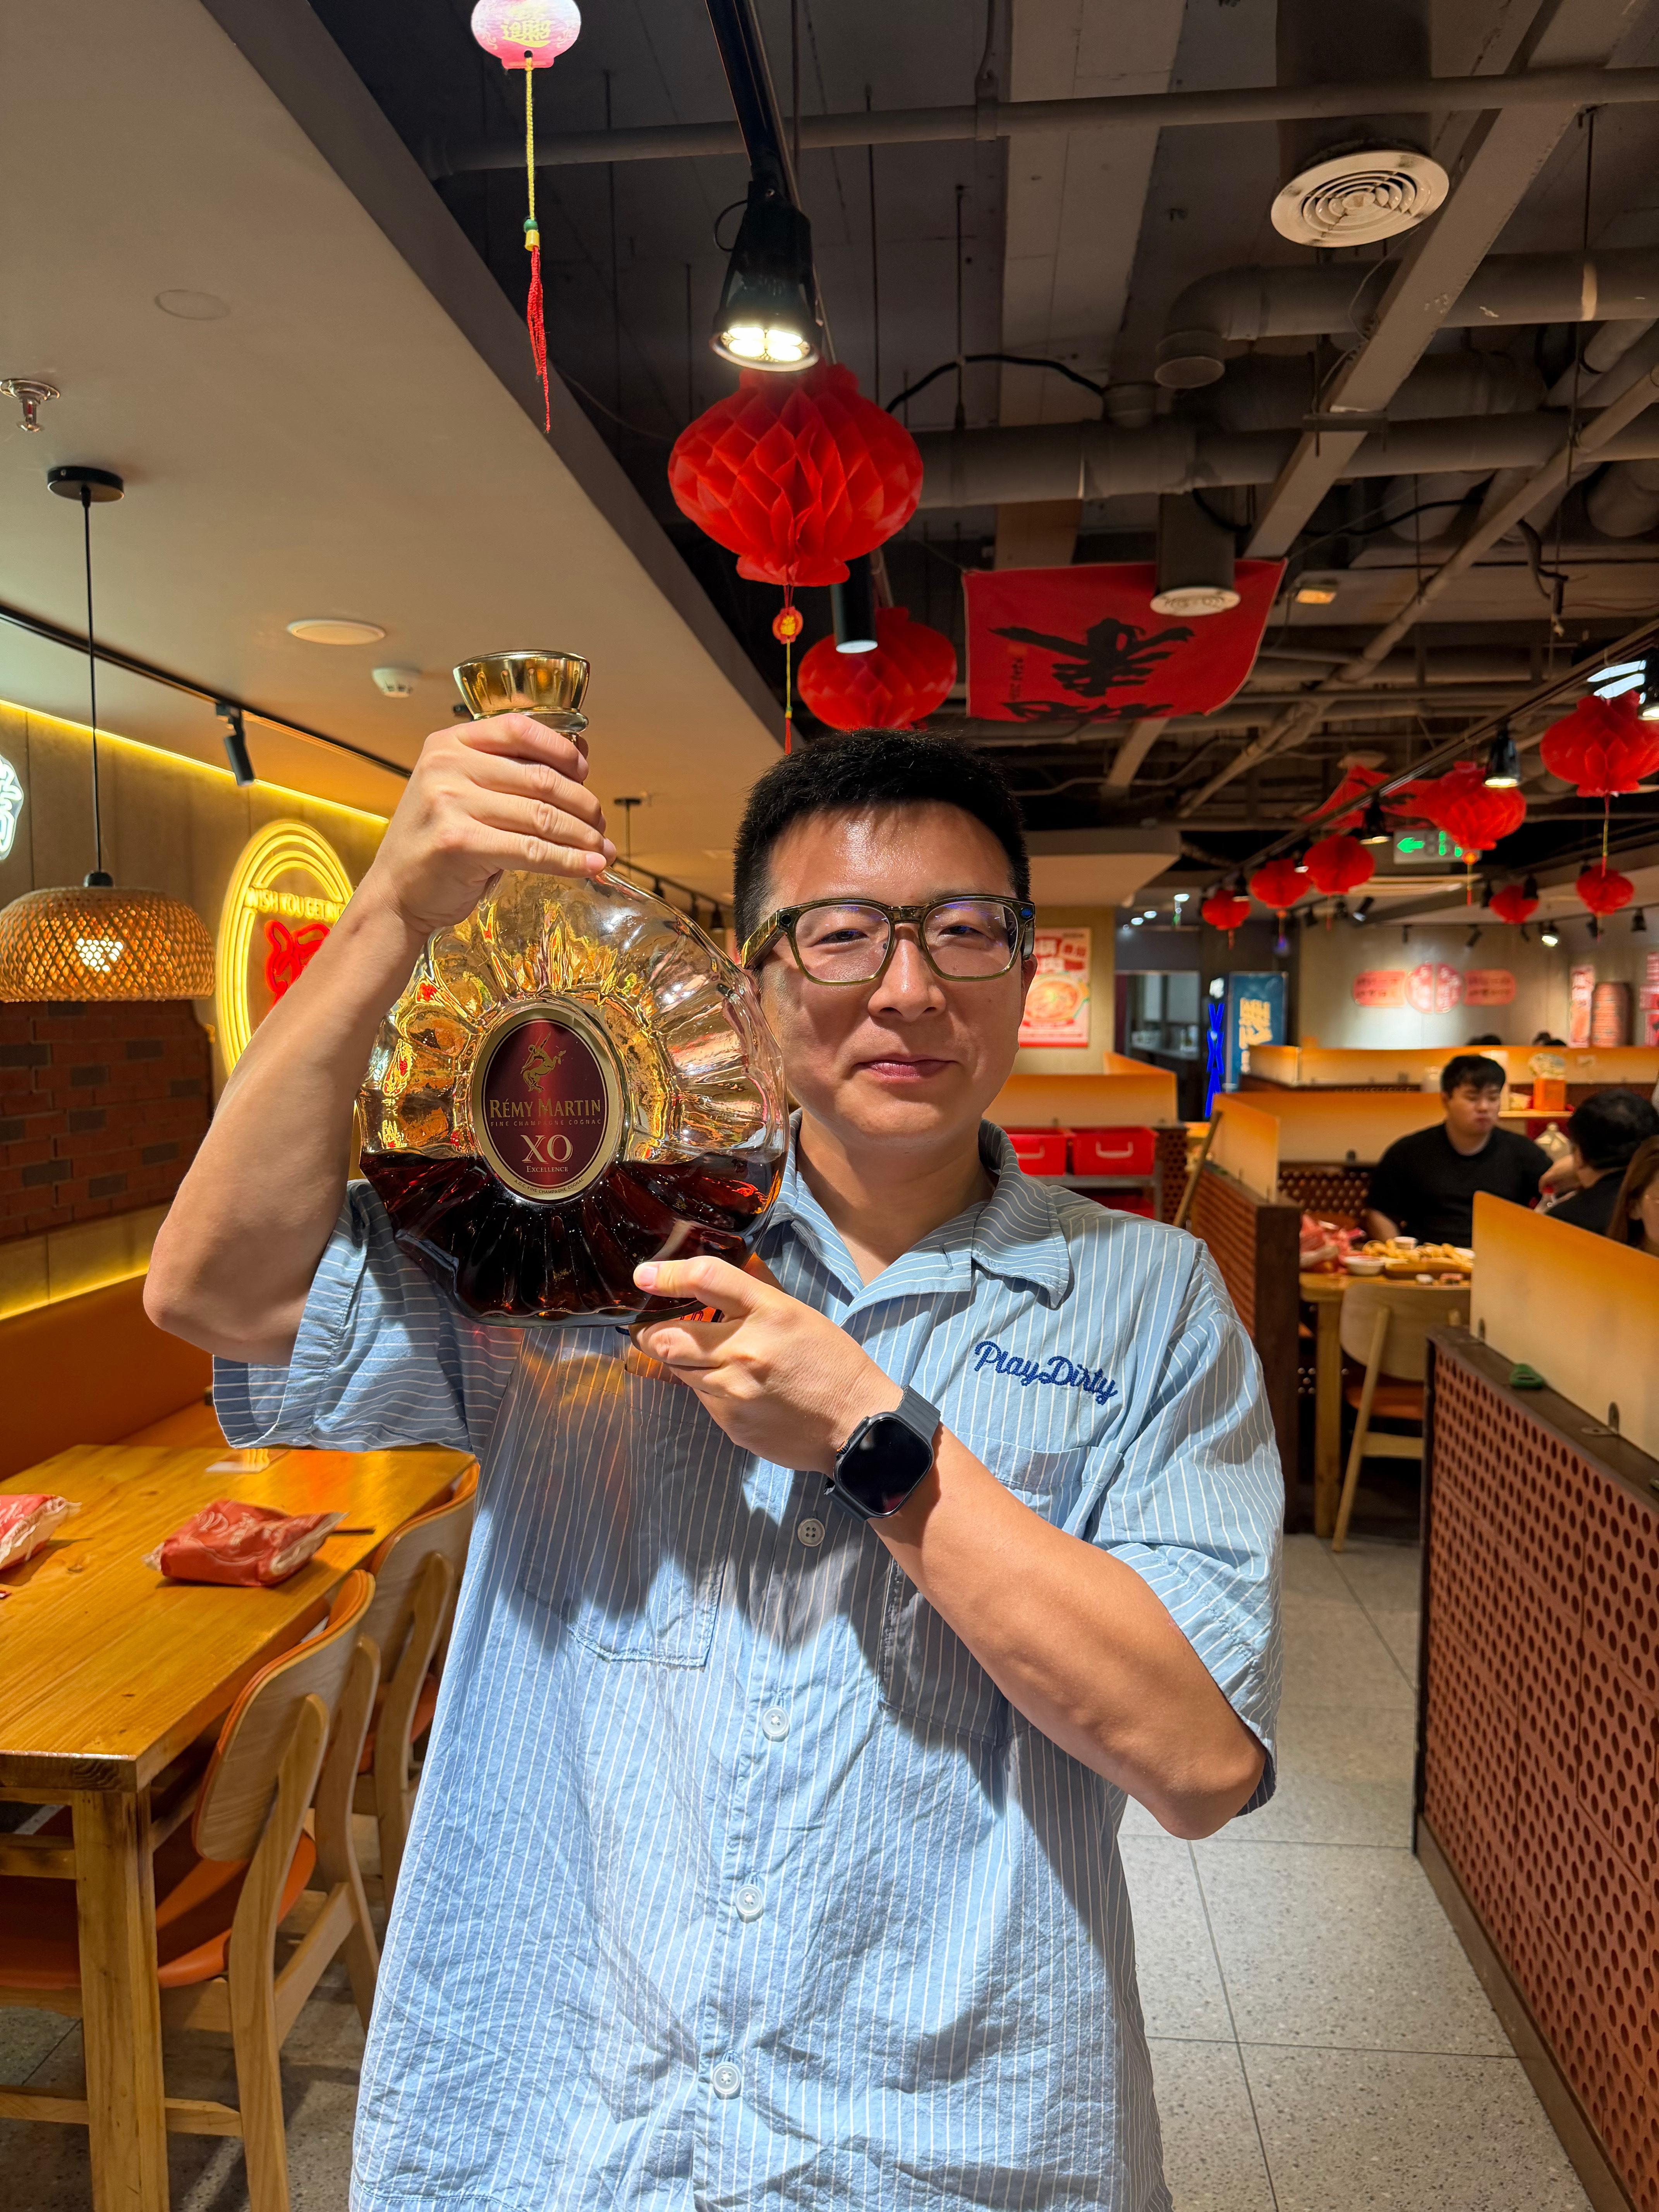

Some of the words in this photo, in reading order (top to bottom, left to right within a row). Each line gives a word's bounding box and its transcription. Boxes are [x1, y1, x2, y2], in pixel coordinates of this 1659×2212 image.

[279, 893, 304, 919] YOU
[489, 1098, 534, 1118] RÉMY
[538, 1098, 600, 1118] MARTIN
[520, 1134, 573, 1164] XO
[568, 1177, 585, 1190] COGNAC
